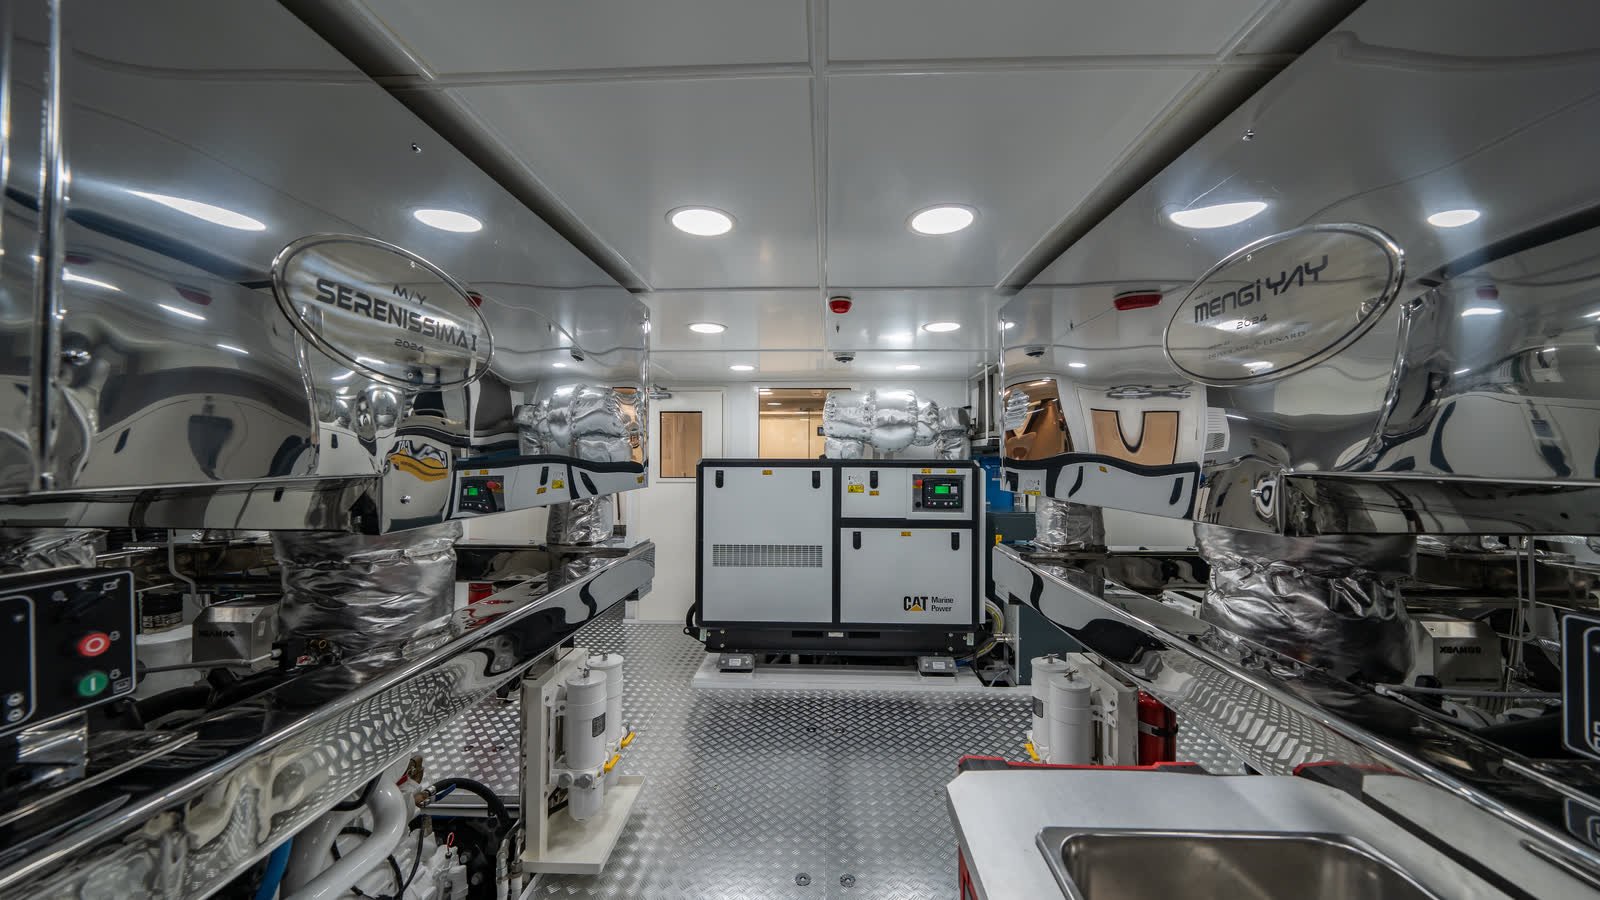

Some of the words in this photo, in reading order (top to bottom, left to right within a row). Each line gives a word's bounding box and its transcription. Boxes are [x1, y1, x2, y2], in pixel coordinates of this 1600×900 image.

[1265, 254, 1329, 296] YAY
[392, 284, 427, 305] M/Y
[315, 277, 470, 350] SERENISSIMA
[1236, 313, 1268, 330] 2024
[394, 338, 425, 353] 2024
[903, 595, 929, 612] CAT
[931, 596, 954, 604] Marine
[931, 604, 953, 612] Power
